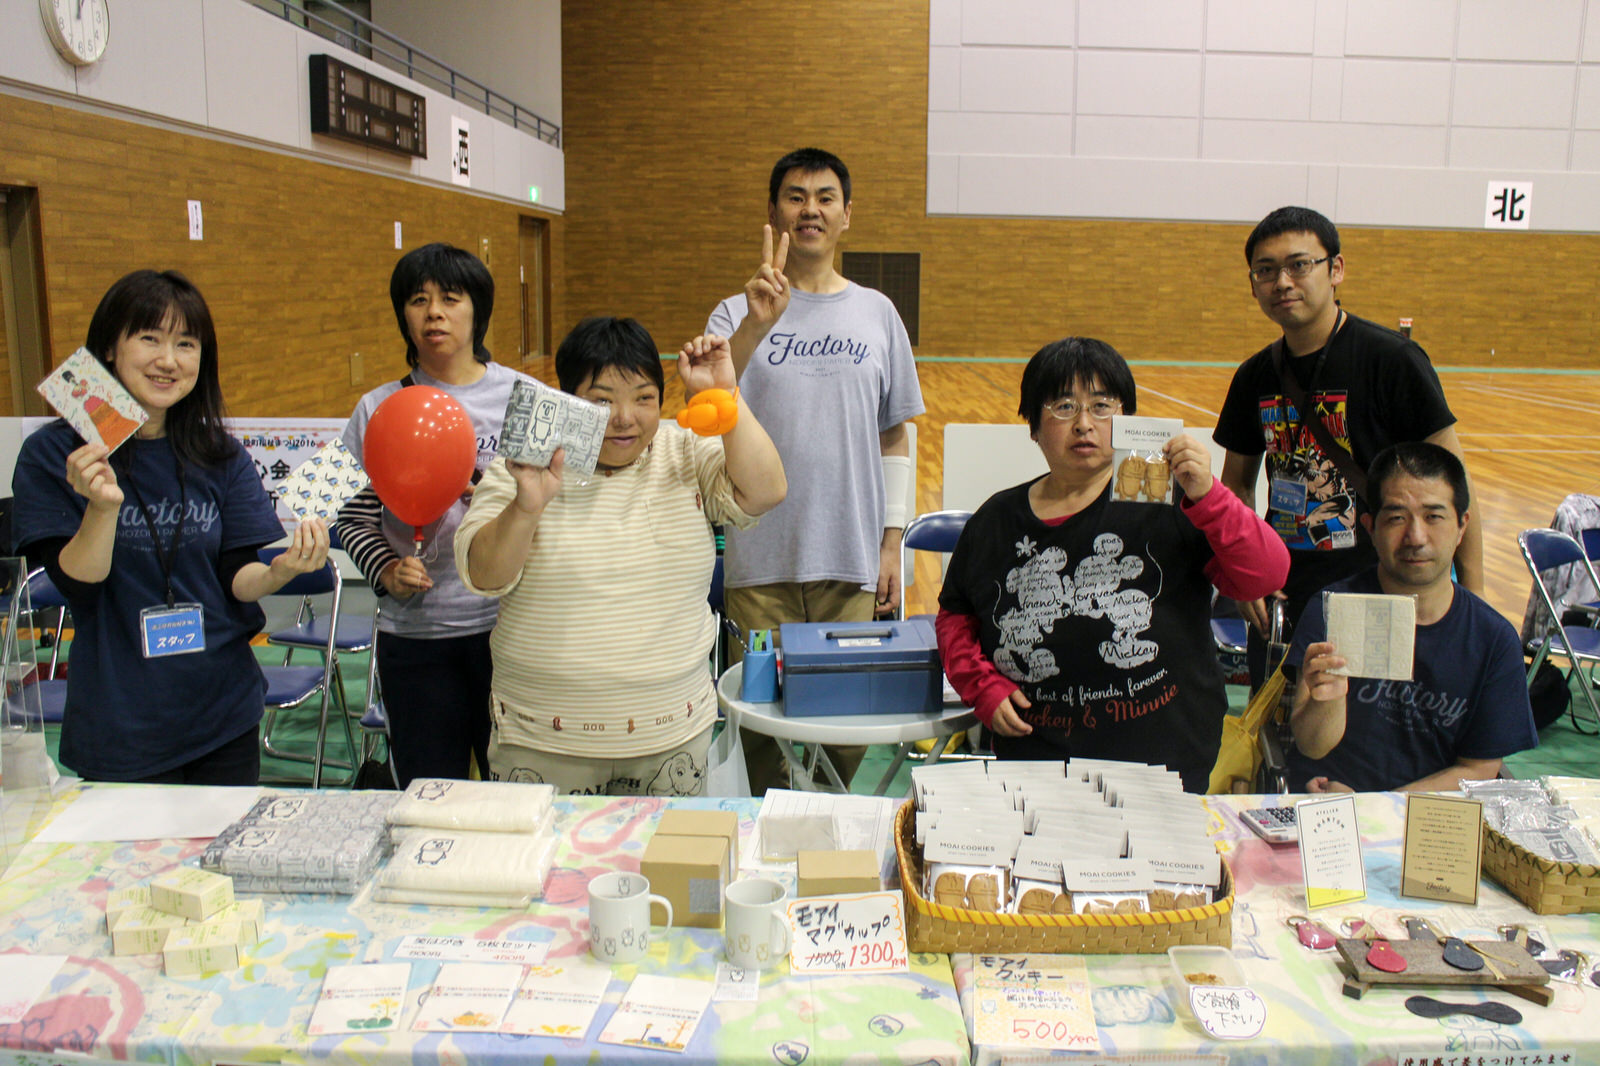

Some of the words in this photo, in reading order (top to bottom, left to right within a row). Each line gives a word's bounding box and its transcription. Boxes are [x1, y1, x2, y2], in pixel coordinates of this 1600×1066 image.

[458, 128, 469, 178] 西
[1492, 188, 1526, 222] 北
[767, 332, 871, 366] Factory
[1142, 430, 1171, 438] COOKIES
[119, 497, 220, 533] actory
[156, 632, 196, 649] スタッフ
[1103, 644, 1158, 661] Mickey
[1062, 686, 1074, 707] of
[1083, 705, 1097, 729] &
[1105, 684, 1179, 722] Minnie
[583, 722, 605, 732] DOG
[655, 715, 674, 726] DOG
[961, 844, 996, 852] COOKIES
[1030, 859, 1050, 867] MOAI
[1169, 862, 1205, 871] COOKIES
[1101, 870, 1137, 878] COOKIES
[795, 902, 839, 928] モアイ
[806, 914, 891, 946] マグカップ
[980, 956, 1028, 970] モアイ
[995, 968, 1064, 983] クッキー
